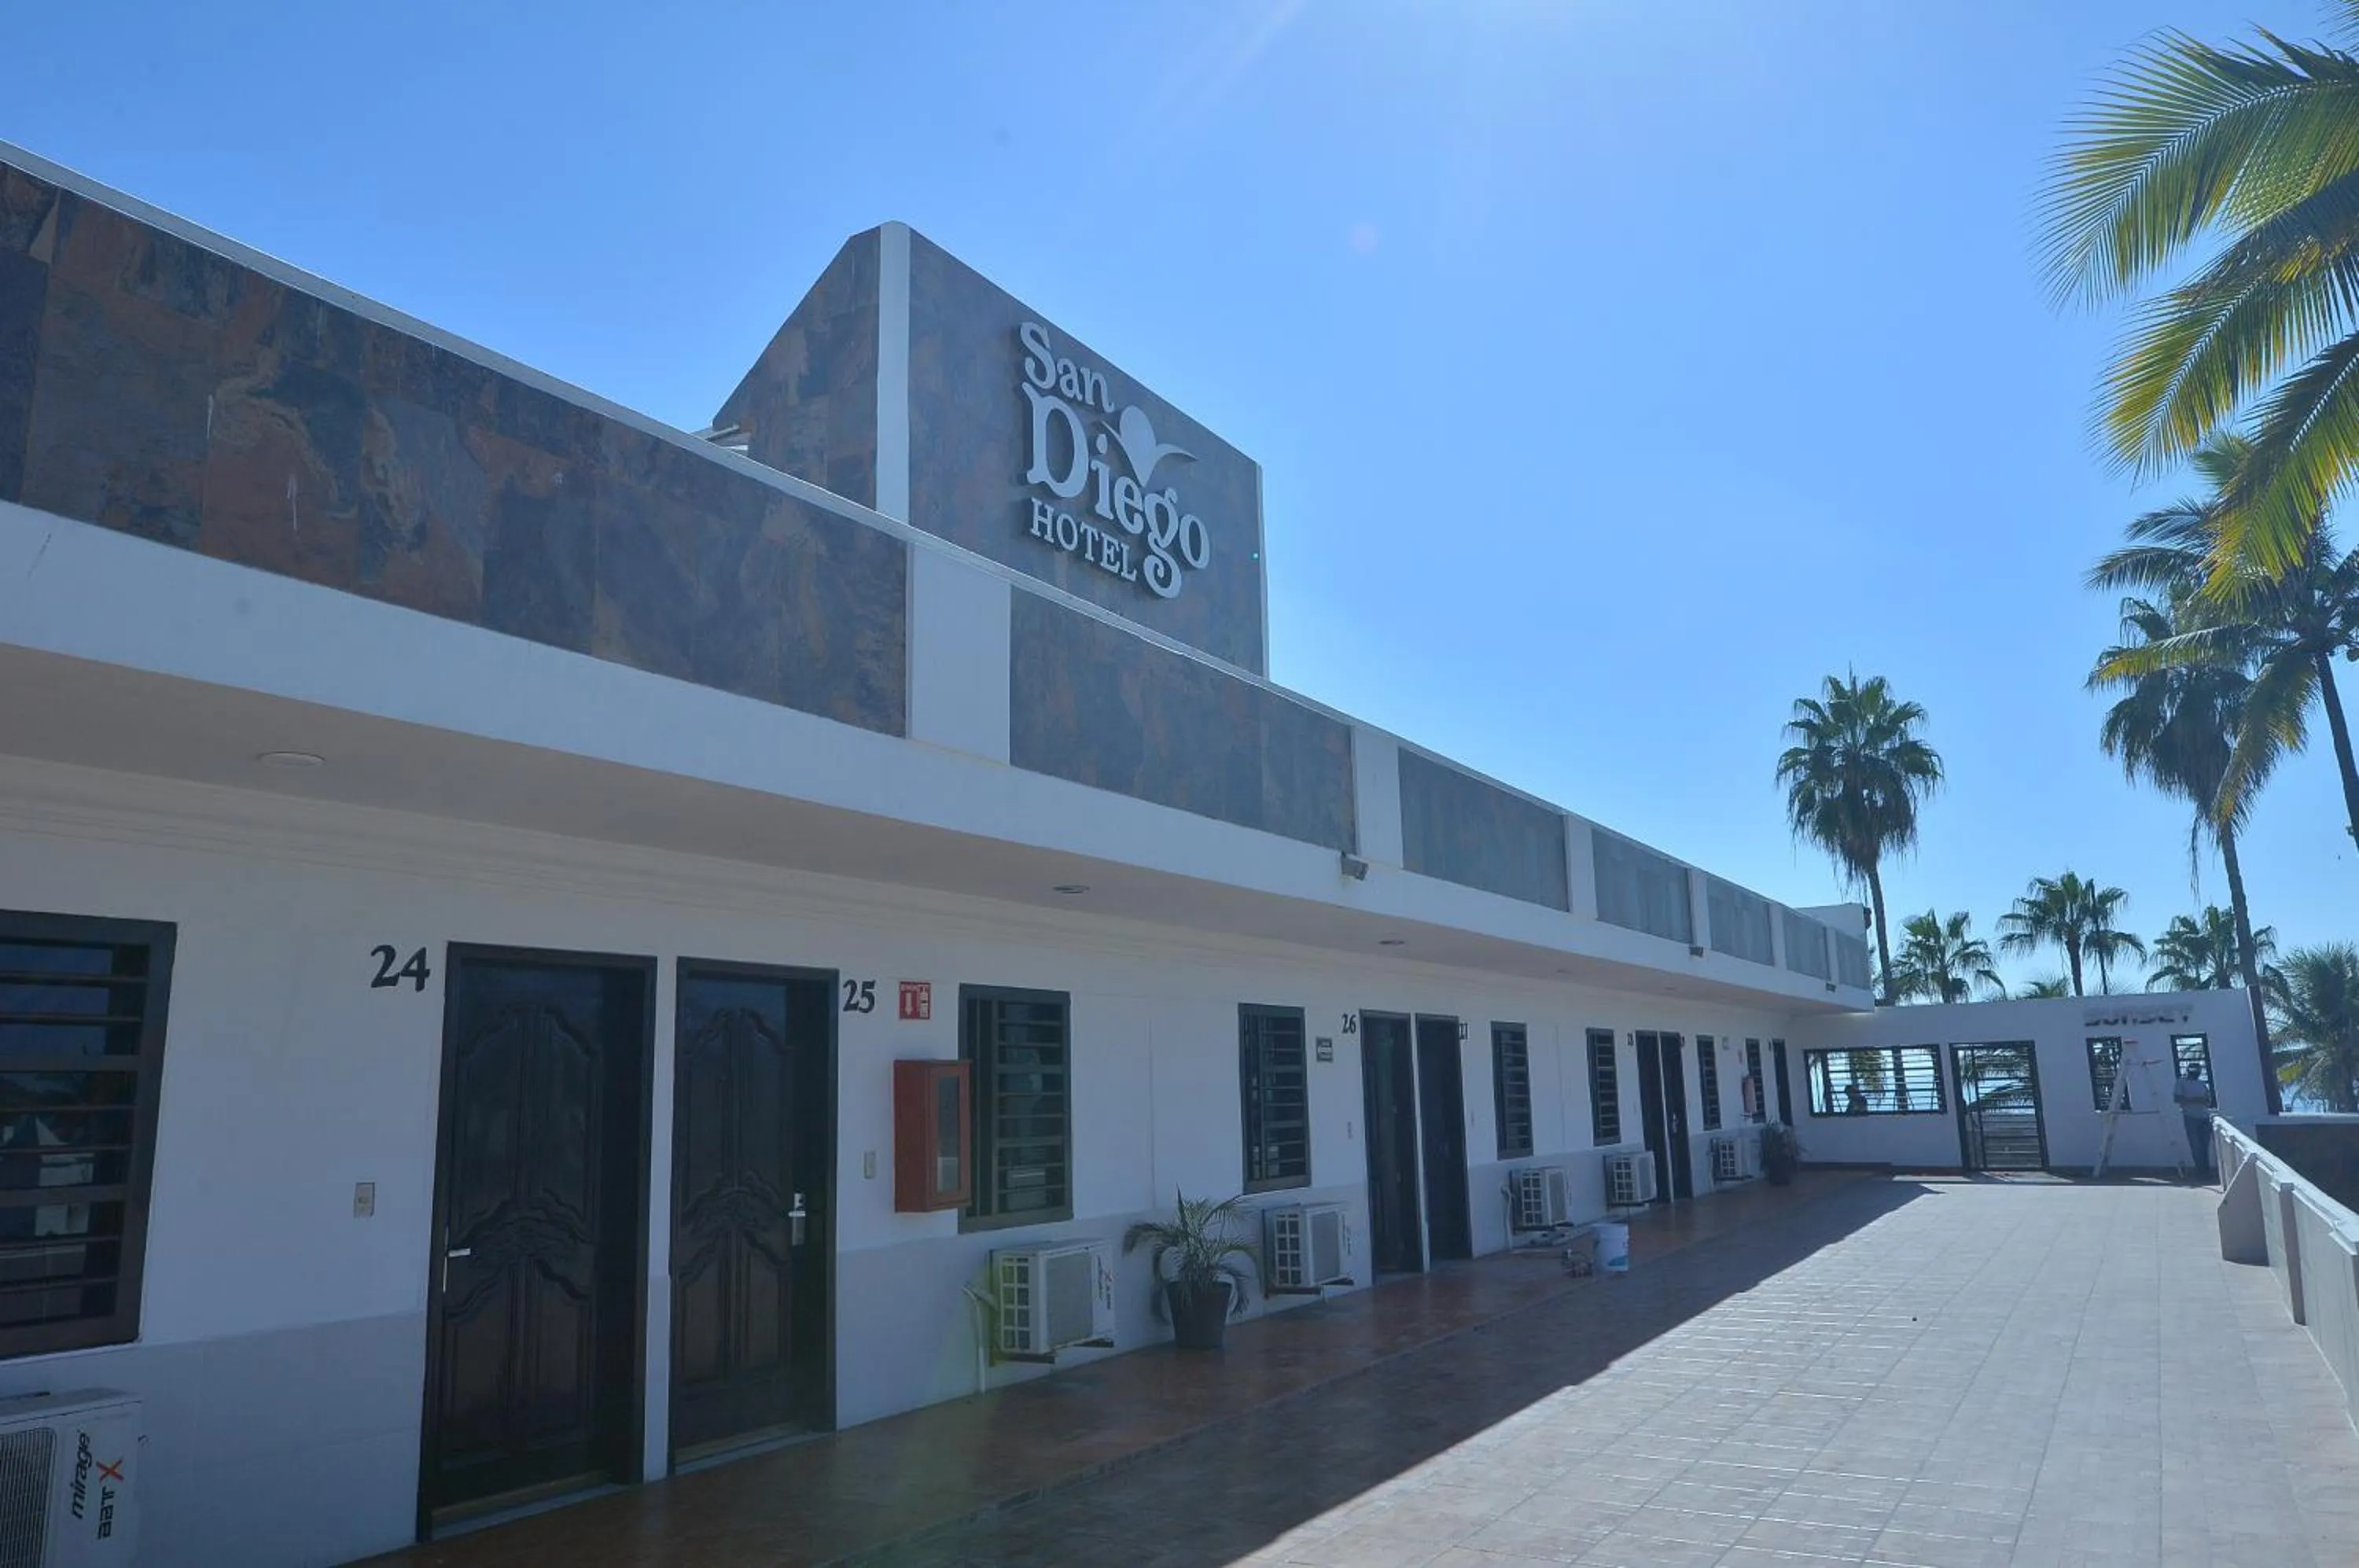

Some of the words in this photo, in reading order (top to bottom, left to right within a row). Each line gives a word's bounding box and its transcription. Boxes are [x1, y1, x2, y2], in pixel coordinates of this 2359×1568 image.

[1021, 321, 1115, 413] San
[1022, 381, 1211, 598] Diego
[1030, 497, 1138, 582] HOTEL
[370, 944, 431, 992] 24
[842, 979, 876, 1014] 25
[1341, 1013, 1357, 1034] 26
[70, 1432, 93, 1519] mirage
